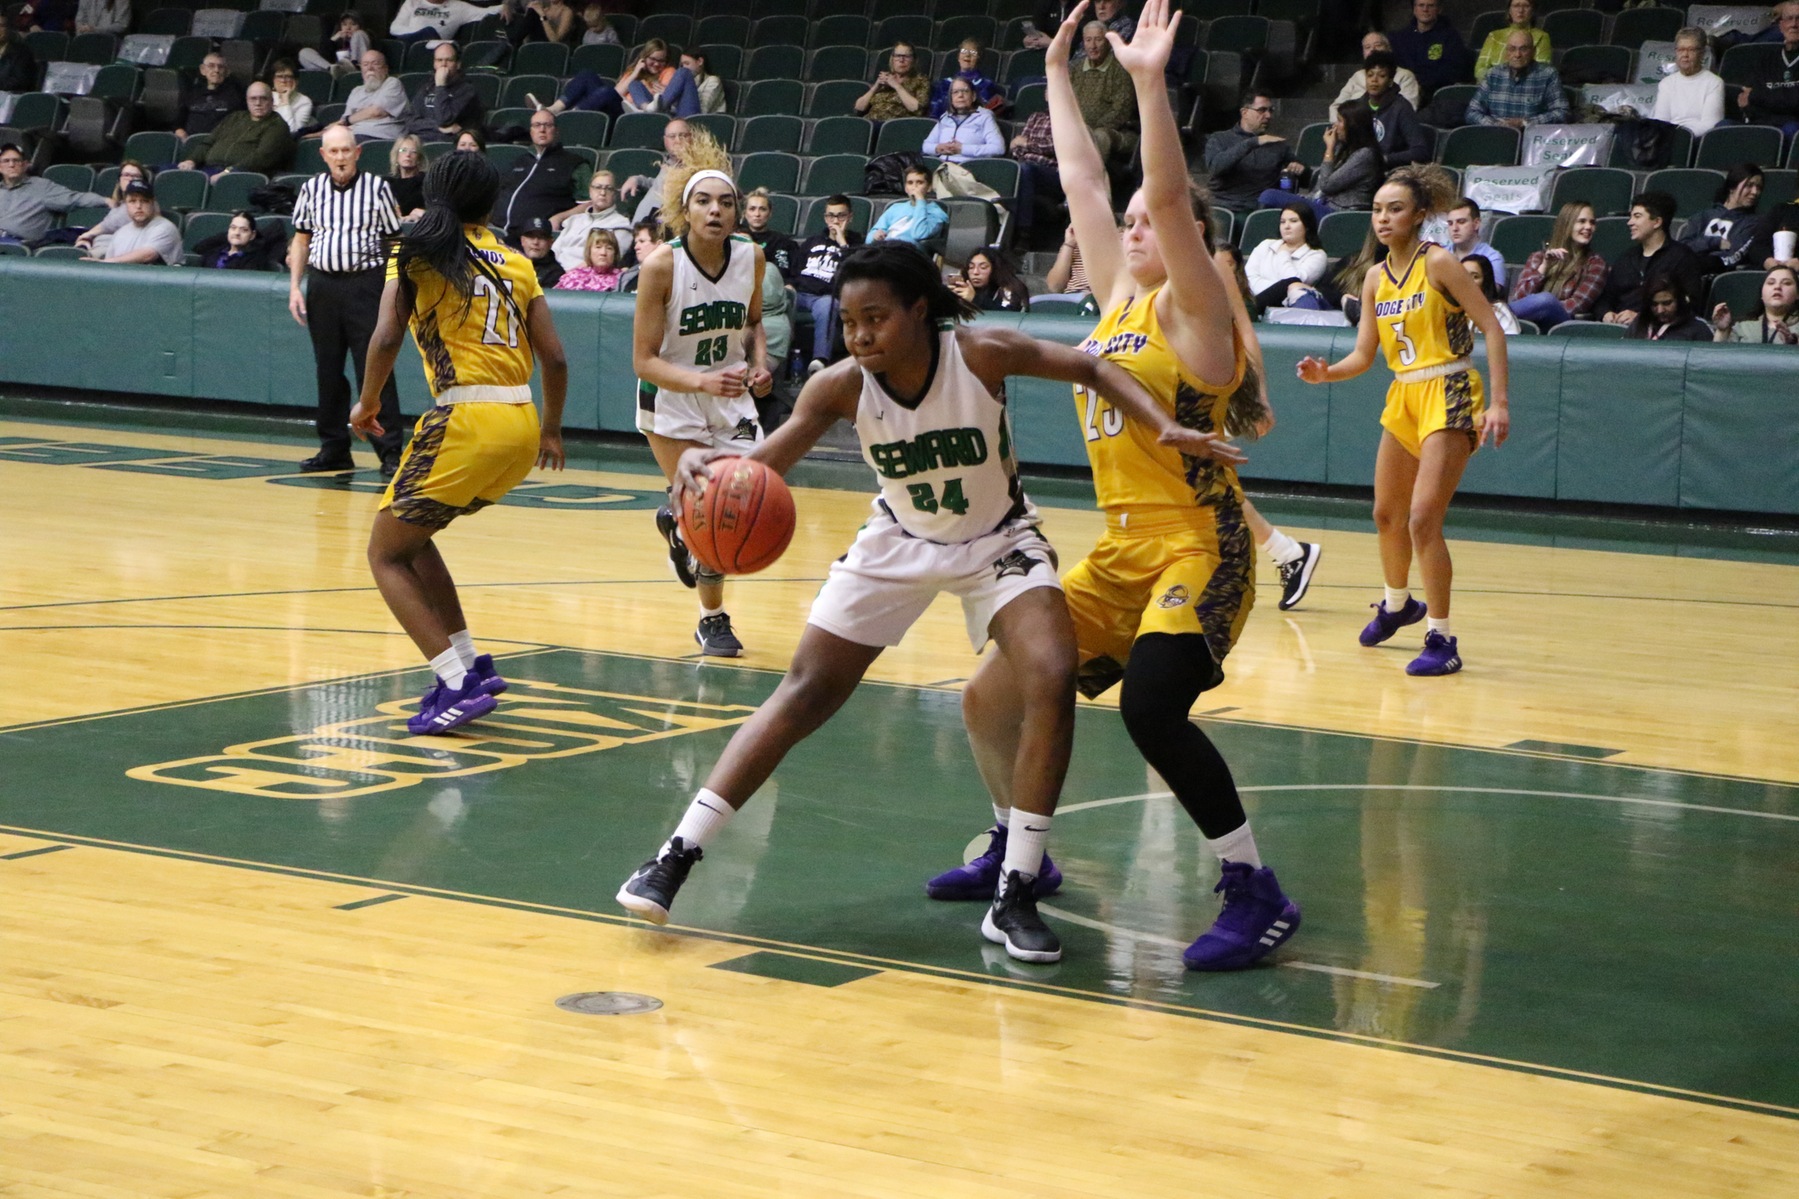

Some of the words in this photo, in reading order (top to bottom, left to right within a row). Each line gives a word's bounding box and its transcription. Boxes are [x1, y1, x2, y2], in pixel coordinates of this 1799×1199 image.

[1696, 16, 1758, 27] Reerved
[1533, 135, 1598, 146] Reserved
[1543, 150, 1574, 161] Sea
[473, 274, 519, 349] 21
[679, 300, 747, 336] SEWARD
[1376, 299, 1404, 317] ODGE
[694, 334, 729, 366] 23
[1104, 333, 1148, 354] CITY
[869, 427, 988, 479] SEWARD
[906, 477, 970, 516] 24
